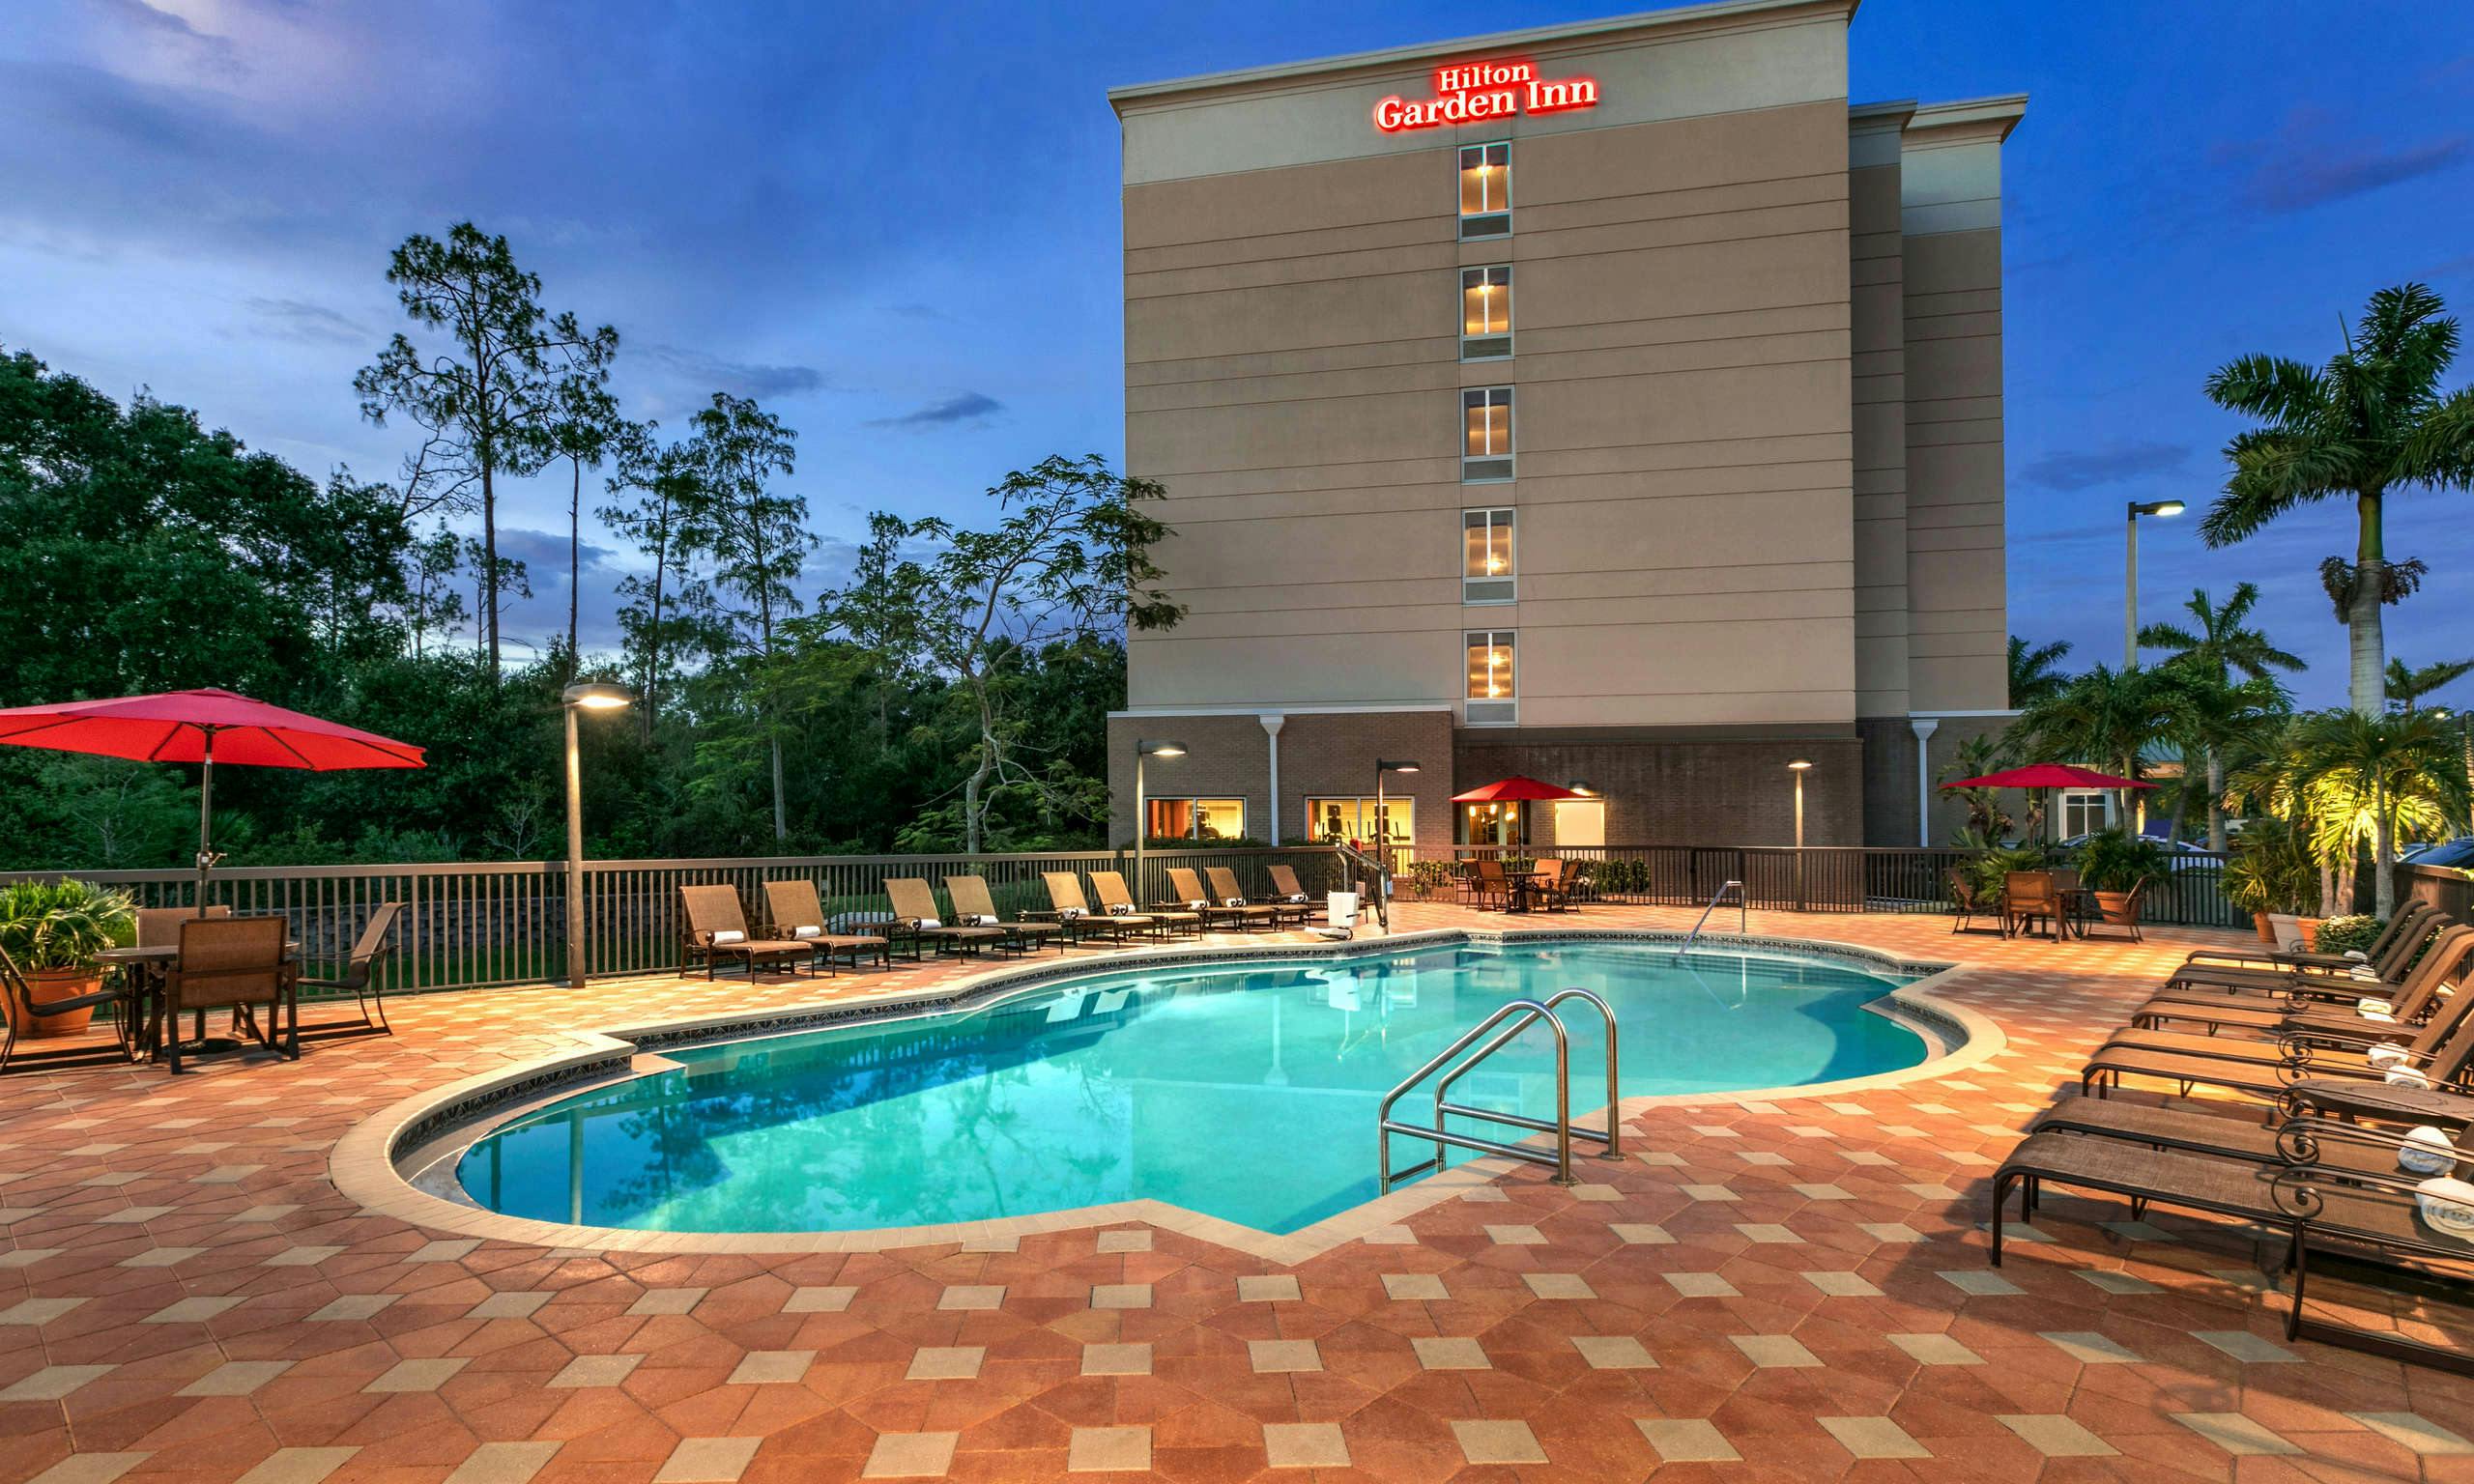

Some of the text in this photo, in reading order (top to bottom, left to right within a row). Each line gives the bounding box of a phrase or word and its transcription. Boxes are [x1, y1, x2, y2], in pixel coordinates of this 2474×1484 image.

[1440, 65, 1531, 92] Hilton
[1376, 80, 1597, 129] Garden Inn
